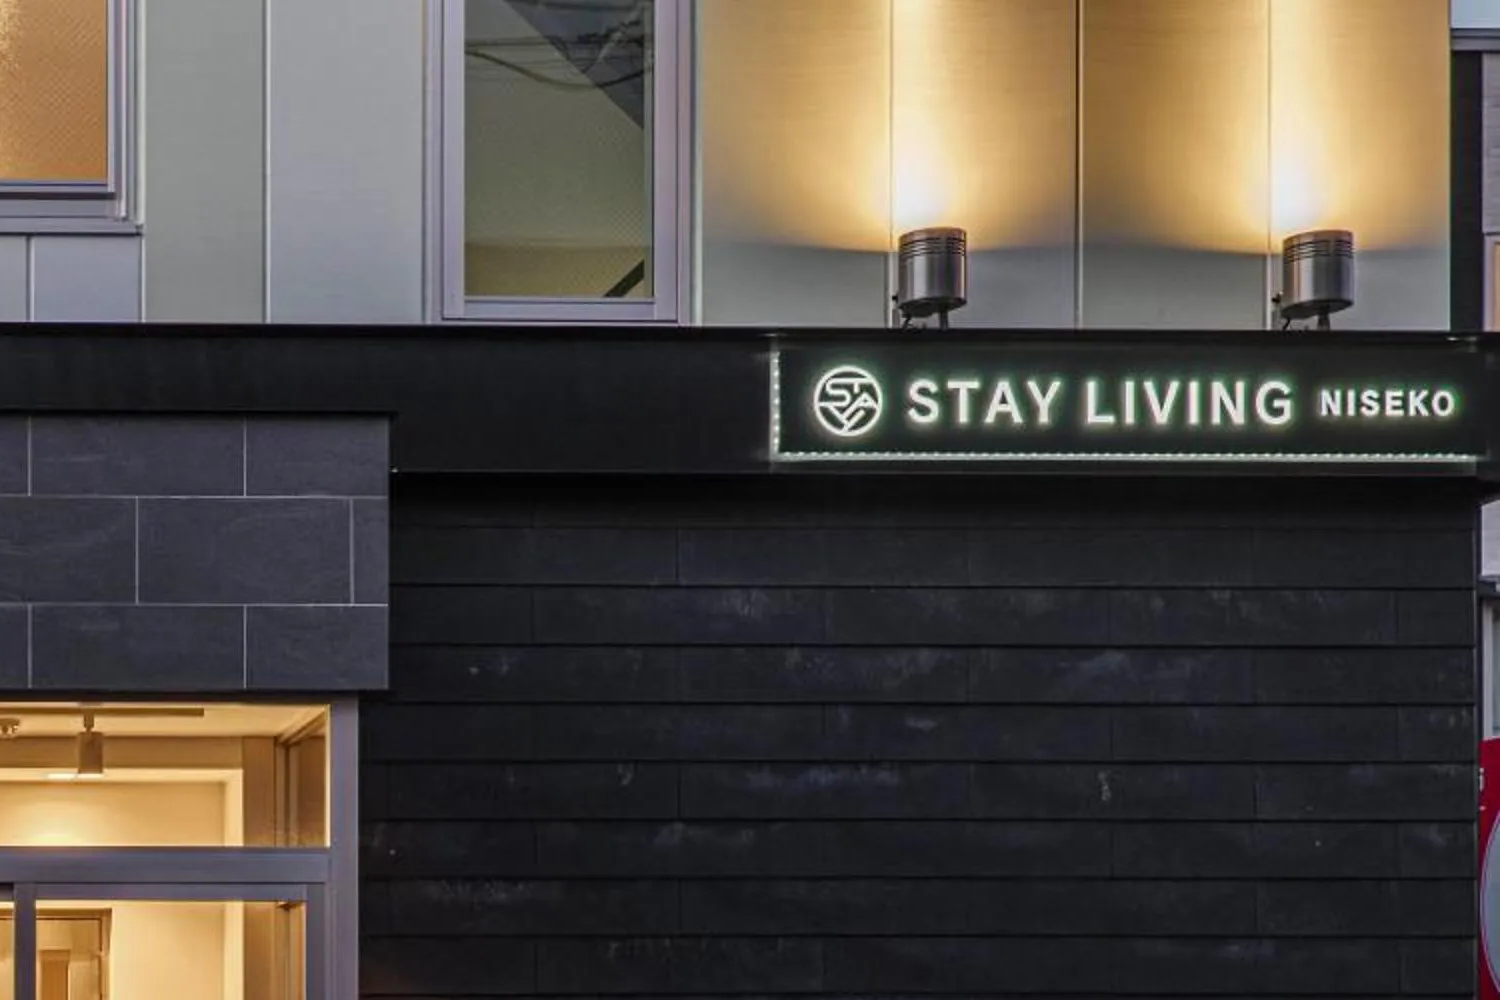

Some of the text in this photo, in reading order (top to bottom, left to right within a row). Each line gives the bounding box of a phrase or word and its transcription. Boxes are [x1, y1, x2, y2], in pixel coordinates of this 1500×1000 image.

[908, 379, 1455, 425] STAY LIVING NISEKO
